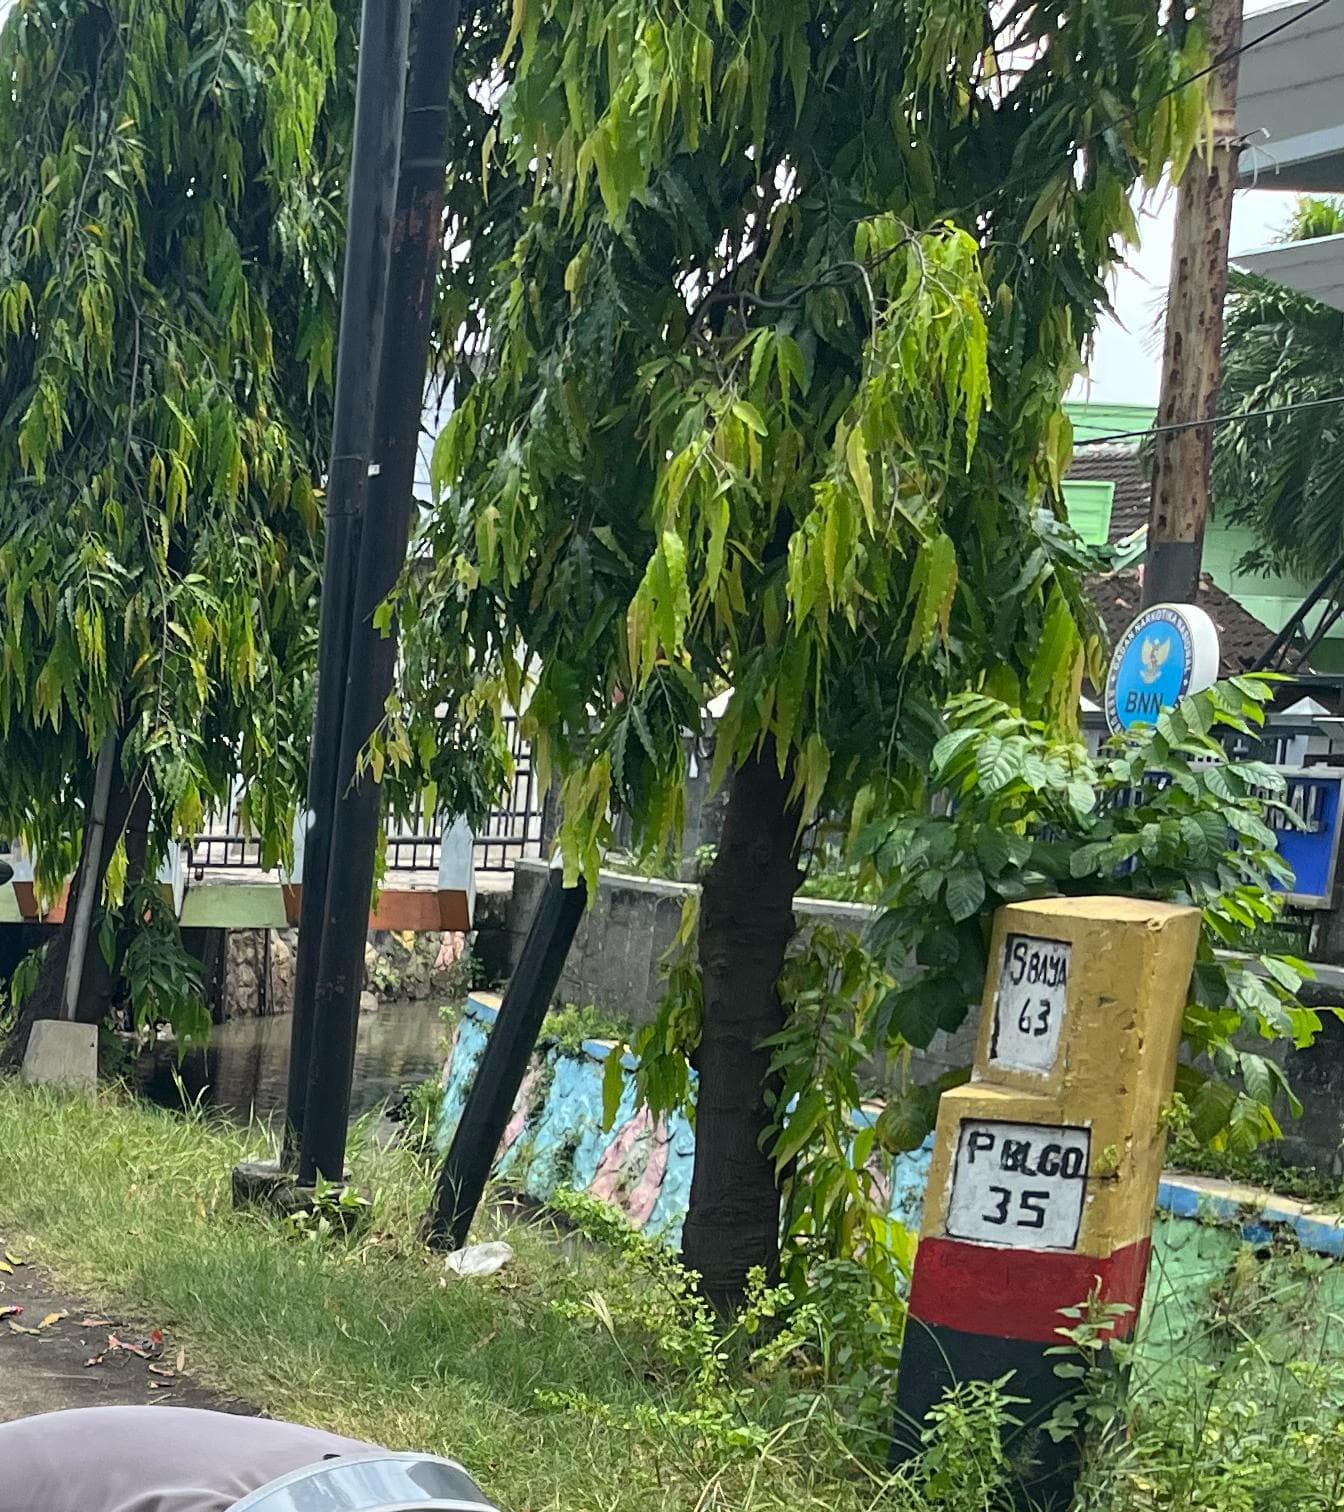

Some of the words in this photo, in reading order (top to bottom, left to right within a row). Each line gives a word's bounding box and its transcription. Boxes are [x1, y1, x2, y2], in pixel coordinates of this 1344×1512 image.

[1125, 691, 1164, 714] BNN
[1017, 998, 1051, 1037] 63
[981, 1186, 1050, 1229] 35
